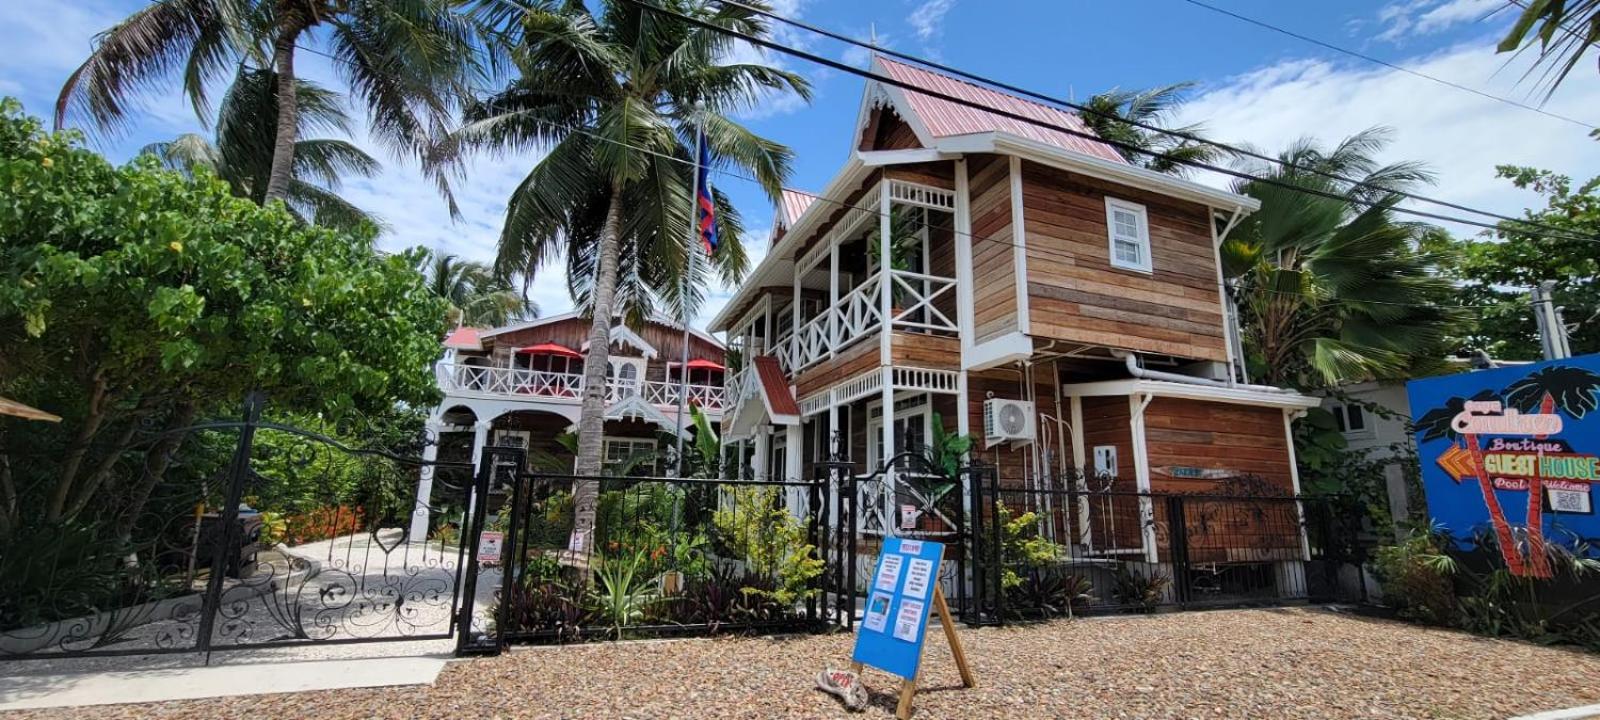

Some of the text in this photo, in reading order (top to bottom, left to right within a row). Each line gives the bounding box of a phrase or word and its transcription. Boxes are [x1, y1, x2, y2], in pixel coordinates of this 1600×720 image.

[1489, 438, 1563, 456] Boutique
[1484, 454, 1600, 480] GUEST HOUSE
[1494, 477, 1527, 490] Pool
